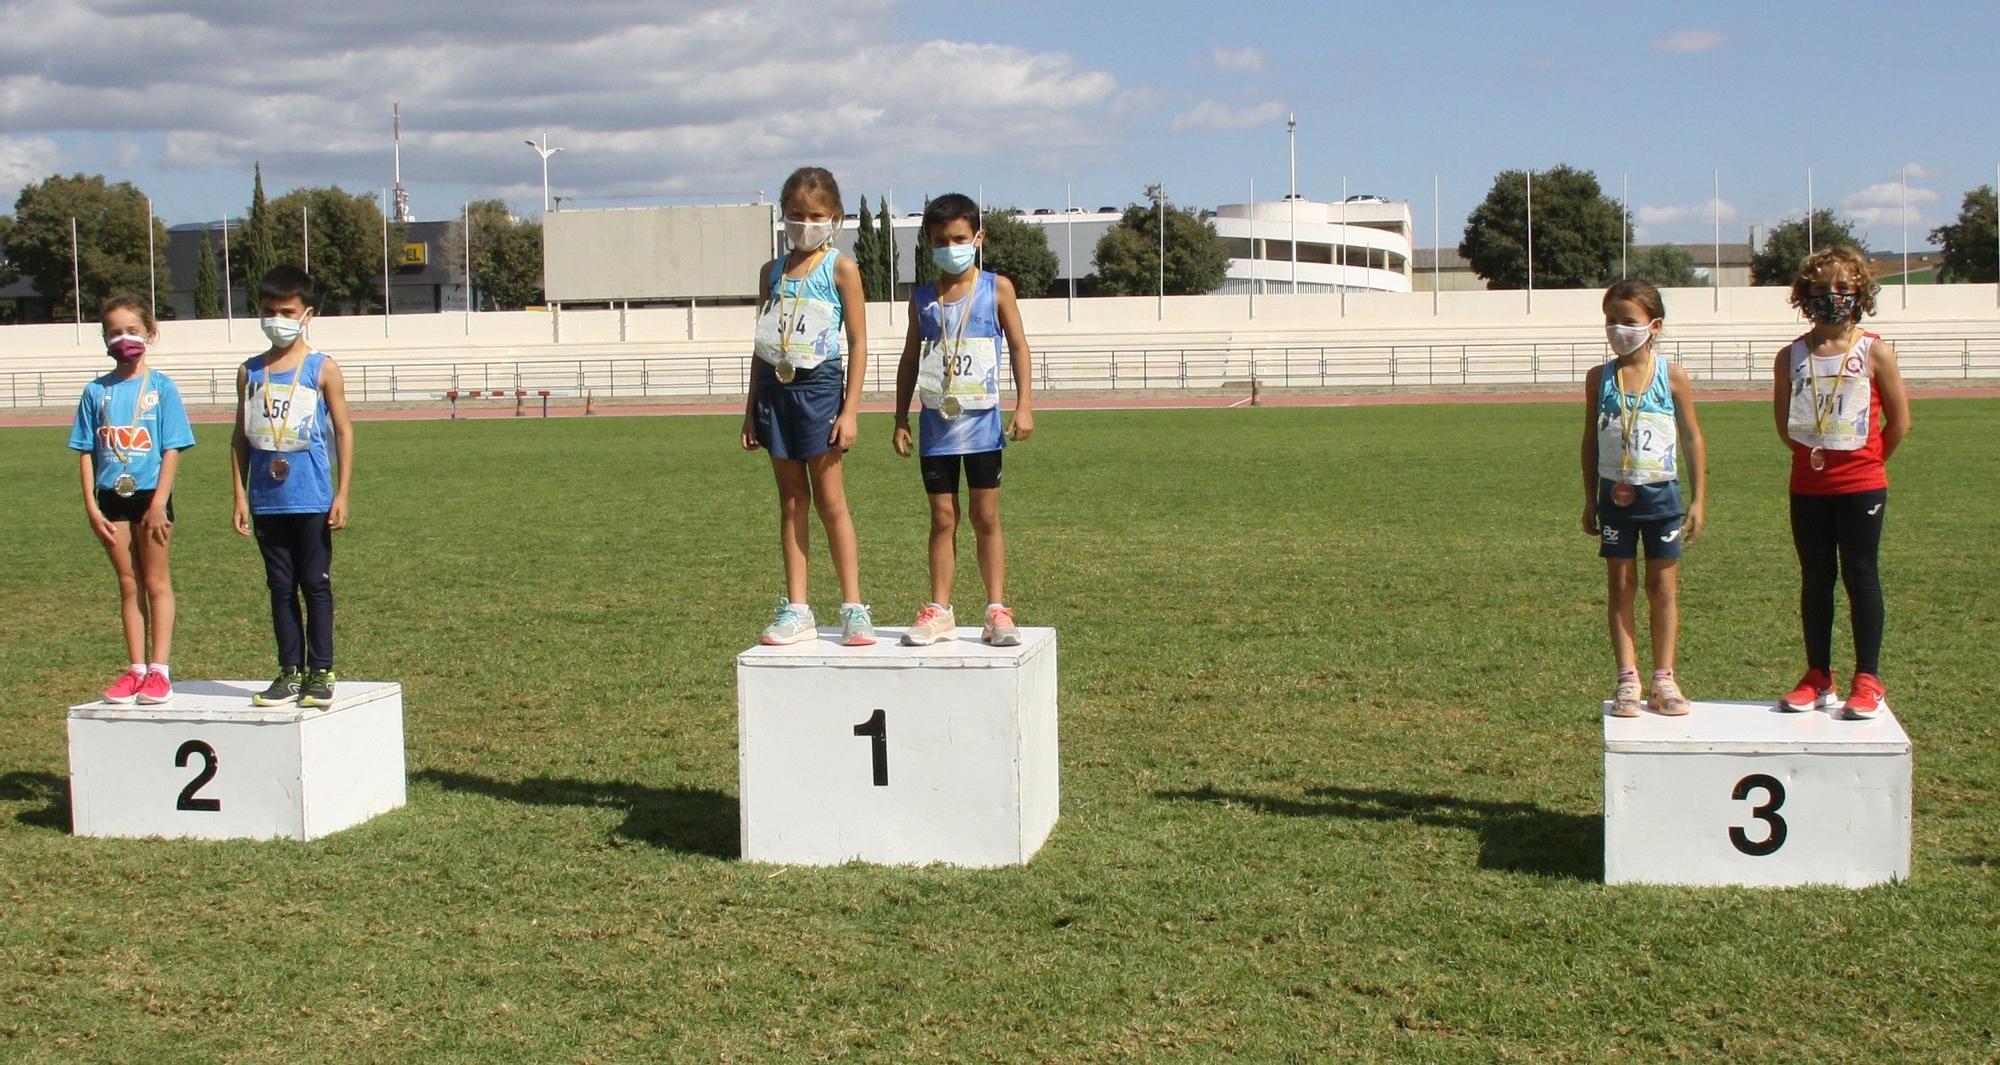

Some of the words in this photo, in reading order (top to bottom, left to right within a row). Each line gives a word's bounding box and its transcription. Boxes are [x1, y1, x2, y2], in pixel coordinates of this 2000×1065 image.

[175, 740, 221, 811] 2
[854, 709, 888, 786] 1
[1728, 774, 1787, 856] 3
